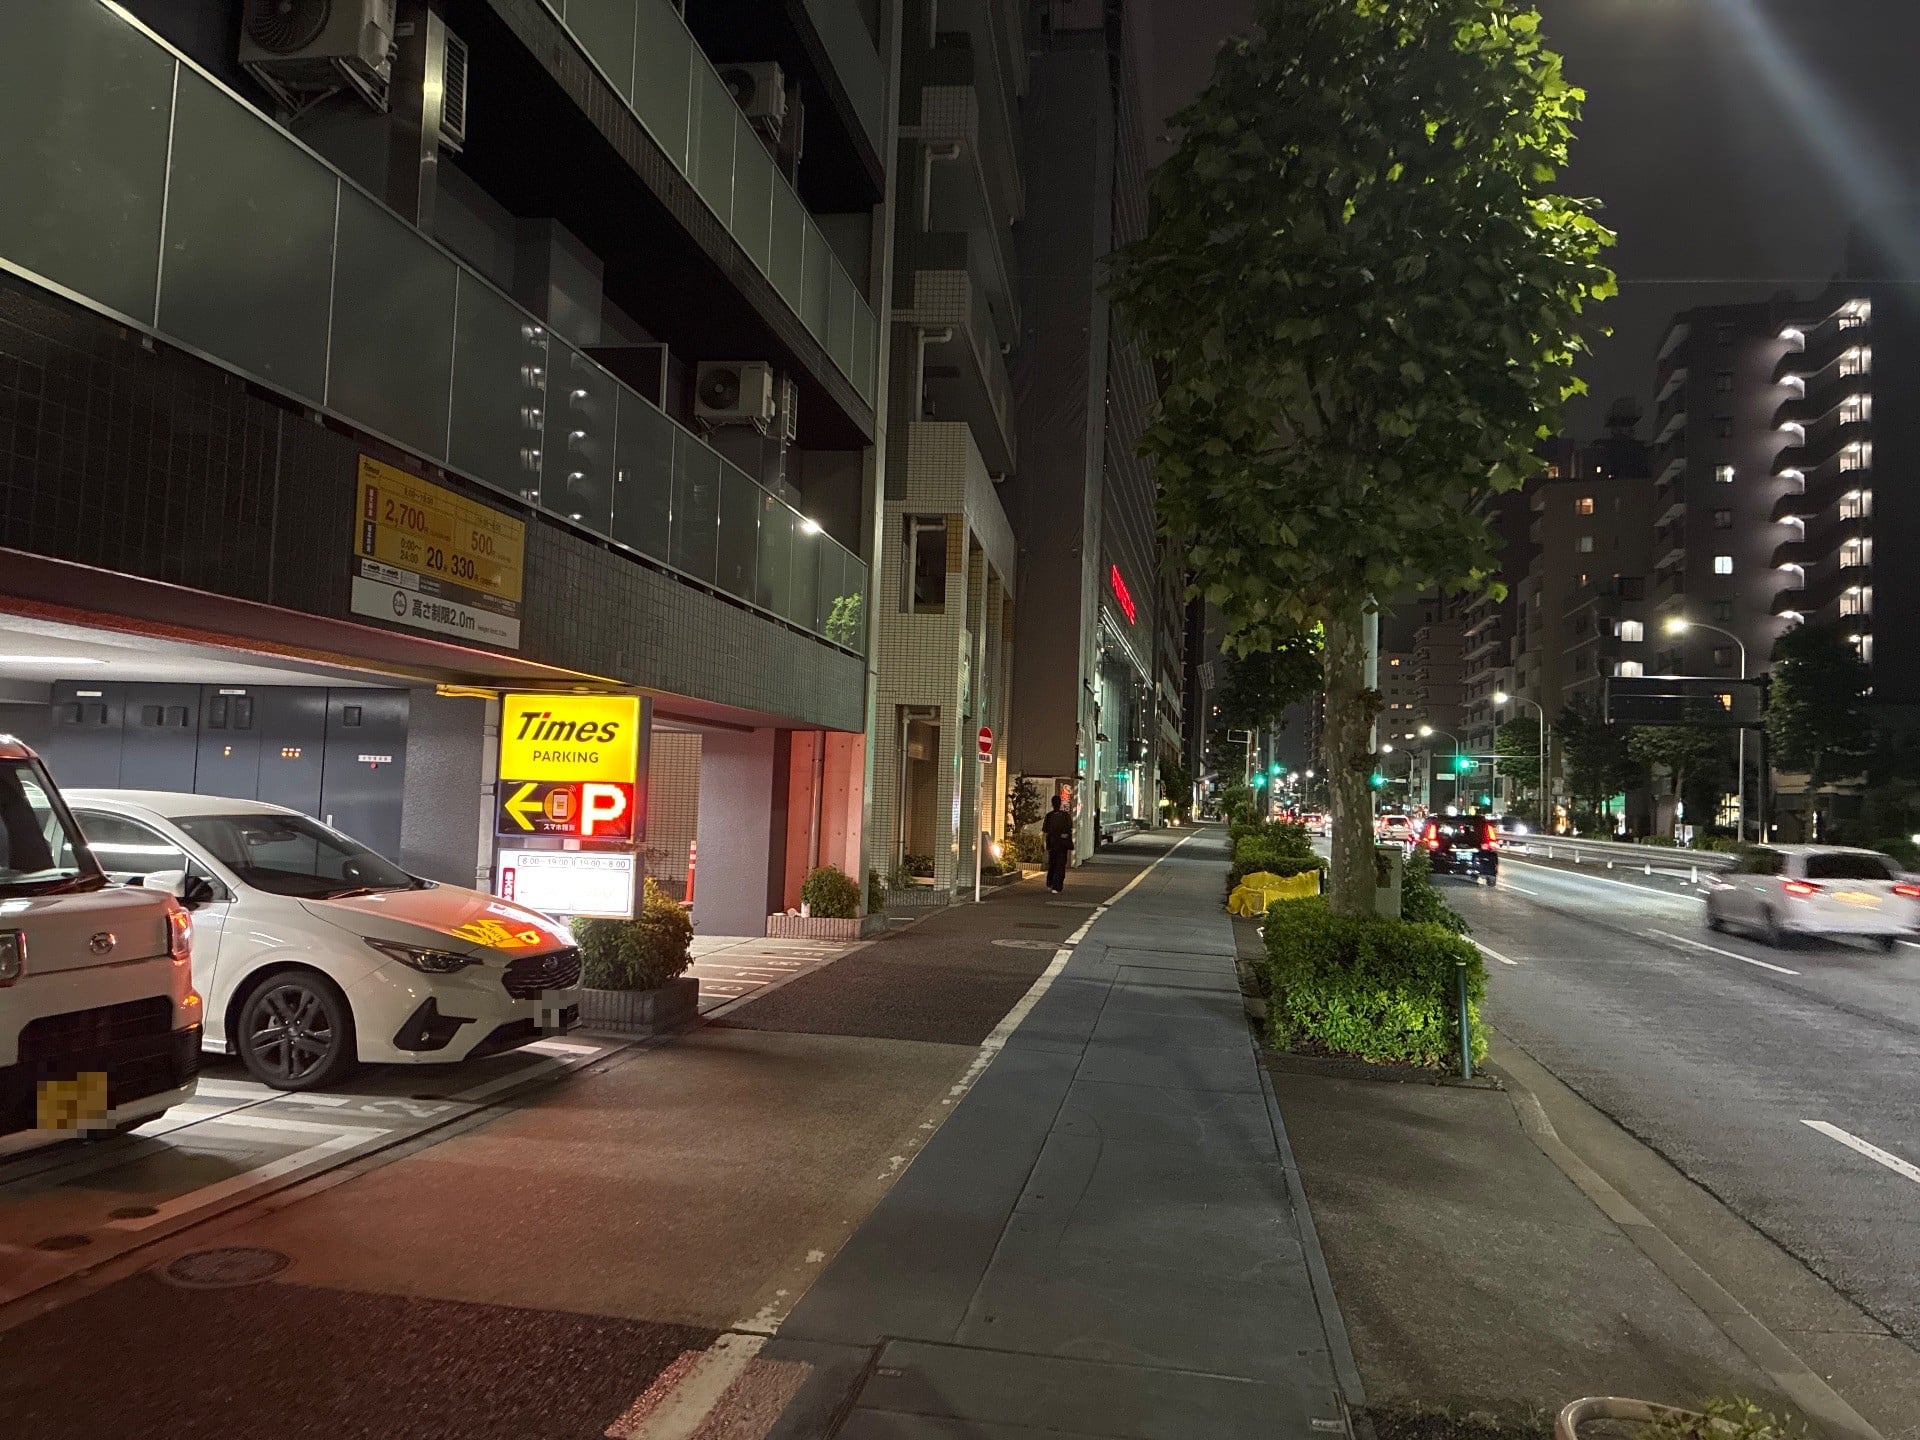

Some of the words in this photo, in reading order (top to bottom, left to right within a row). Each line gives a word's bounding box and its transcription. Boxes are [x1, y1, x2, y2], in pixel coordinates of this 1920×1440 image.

[412, 599, 475, 630] 高さ制限2.0m
[517, 712, 619, 743] Times
[533, 751, 598, 763] PARKING
[581, 783, 626, 835] P
